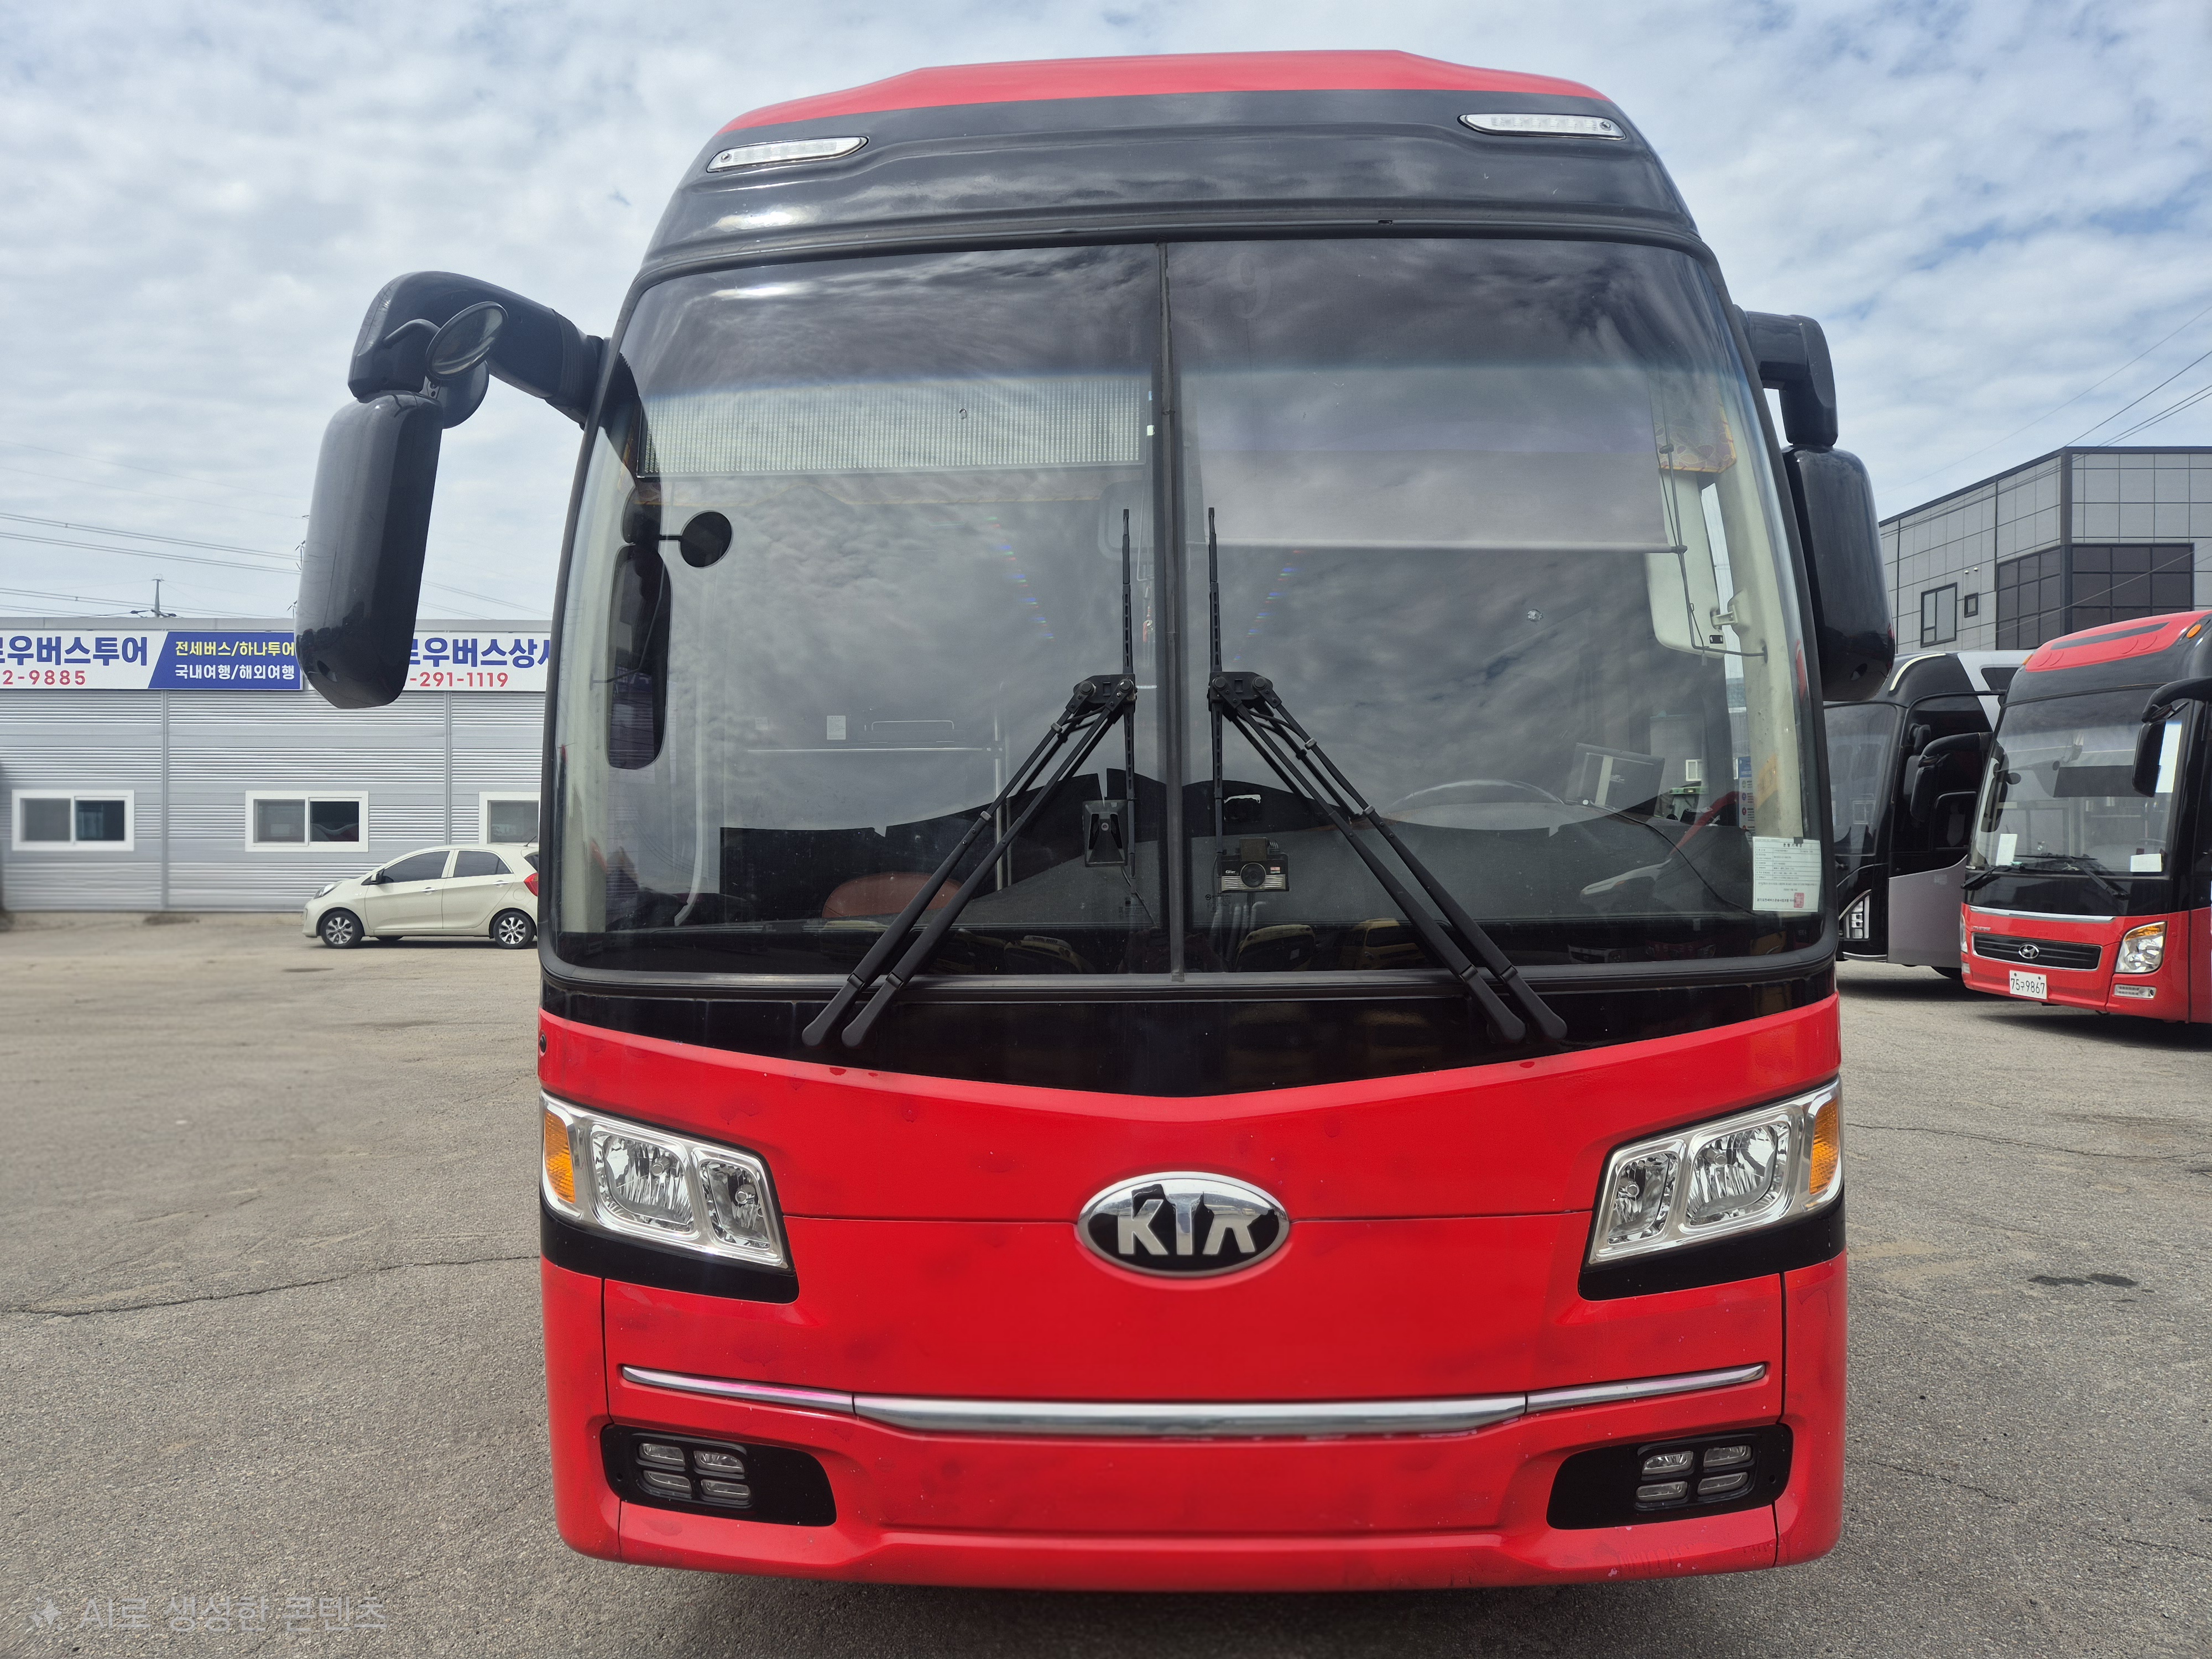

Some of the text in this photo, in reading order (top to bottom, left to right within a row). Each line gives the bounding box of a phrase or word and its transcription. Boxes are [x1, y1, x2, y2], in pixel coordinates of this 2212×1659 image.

[0, 635, 147, 666] 우버스투어
[175, 641, 294, 656] 전세버스/하나투어
[2, 670, 86, 685] 2-9885
[175, 664, 294, 680] 국내여행/해외여행
[2011, 978, 2045, 994] 75구9867
[1117, 1194, 1256, 1255] KIA
